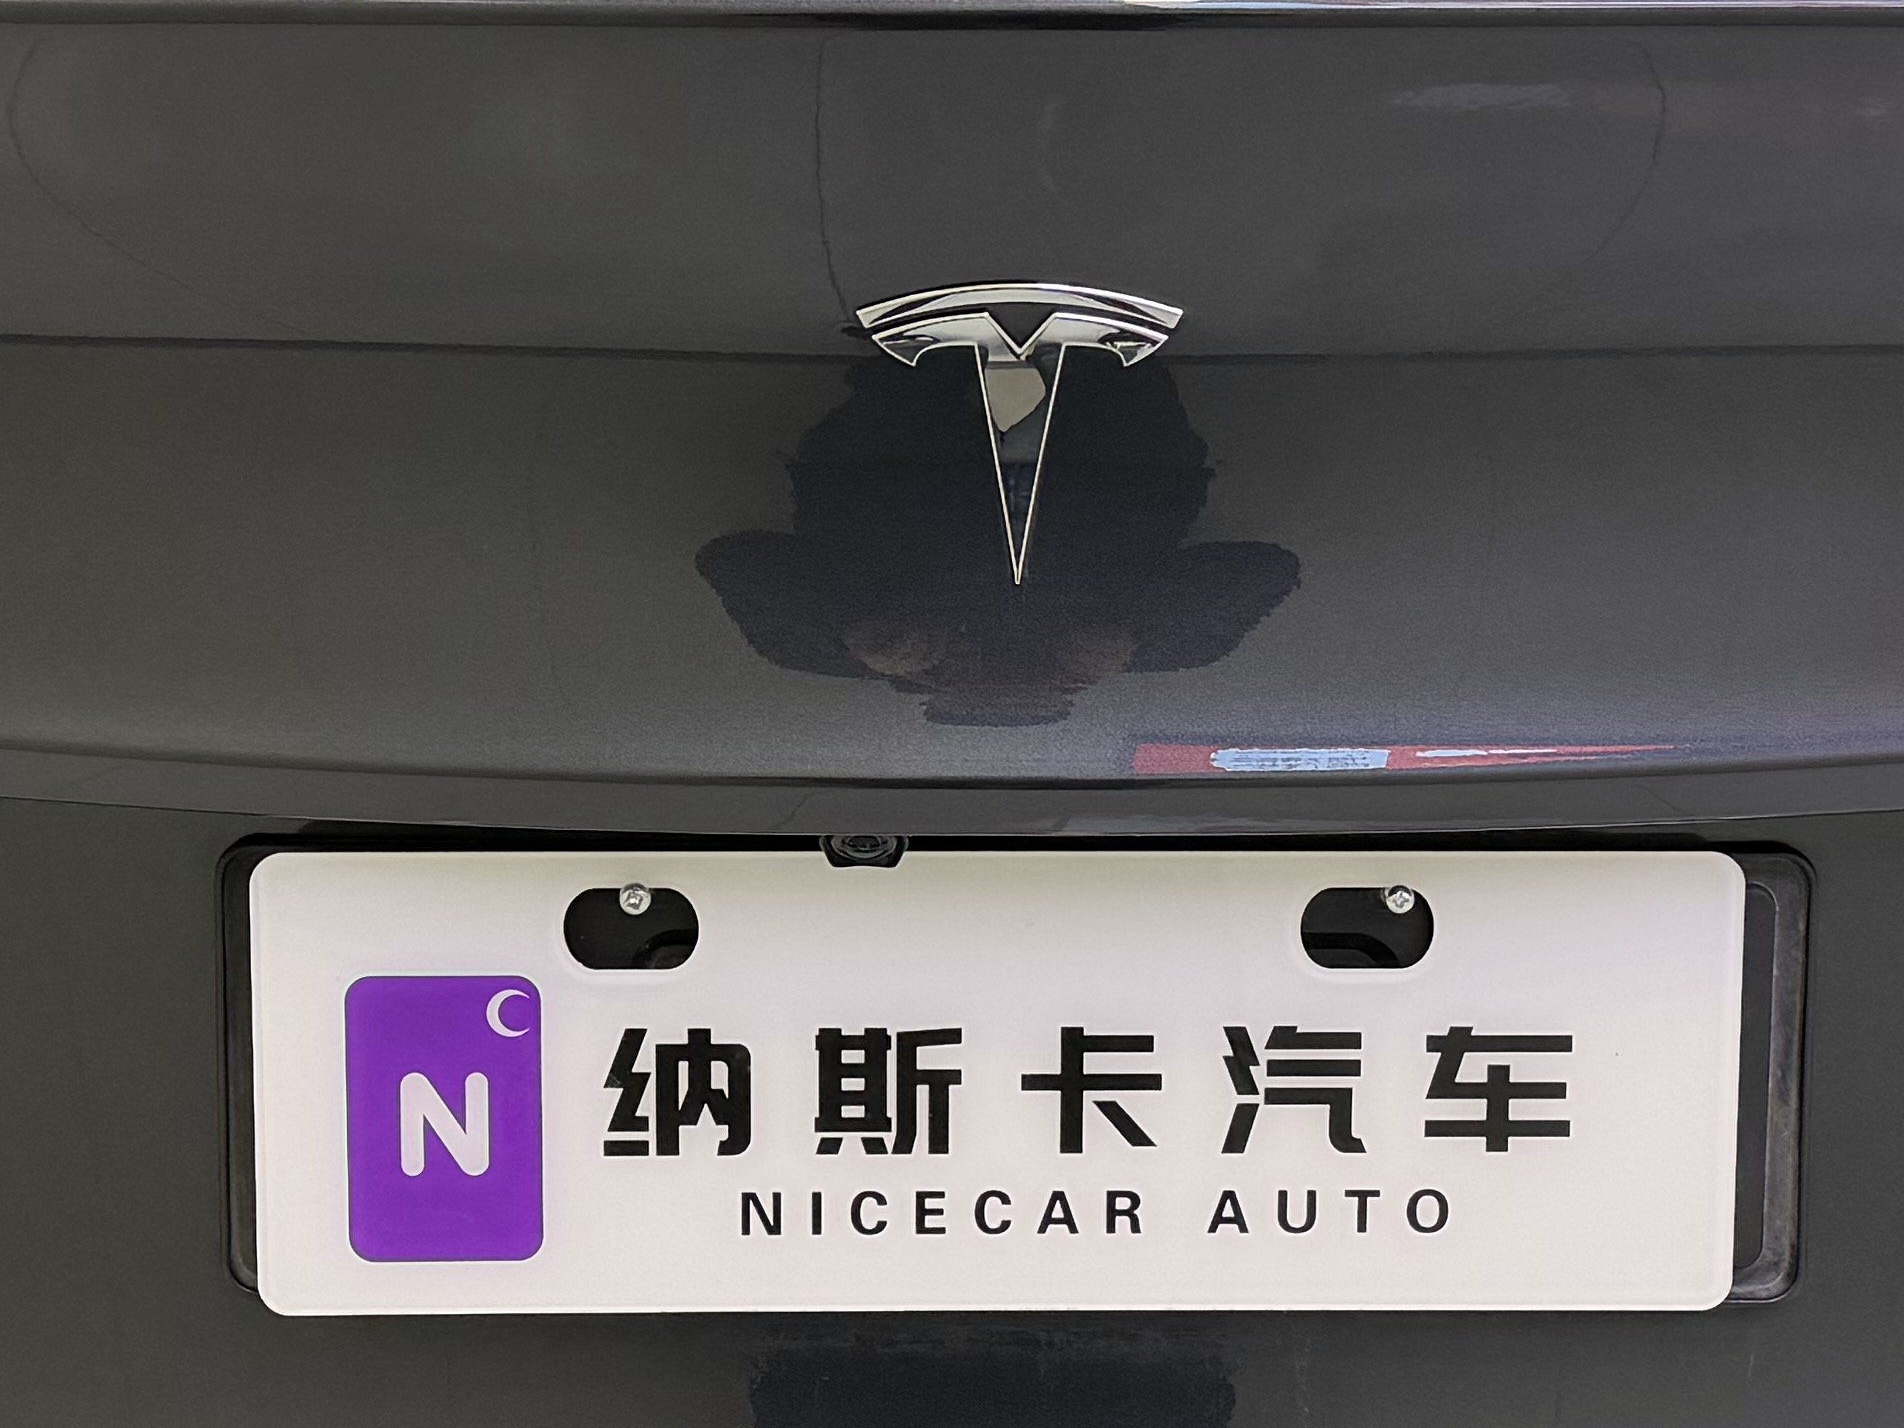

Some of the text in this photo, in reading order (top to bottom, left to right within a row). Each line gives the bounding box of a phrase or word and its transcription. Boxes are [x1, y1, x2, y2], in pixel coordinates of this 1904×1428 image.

[399, 1071, 490, 1177] N
[603, 1025, 1573, 1156] 纳斯卡汽车
[741, 1188, 1449, 1236] NICECAR AUTO
